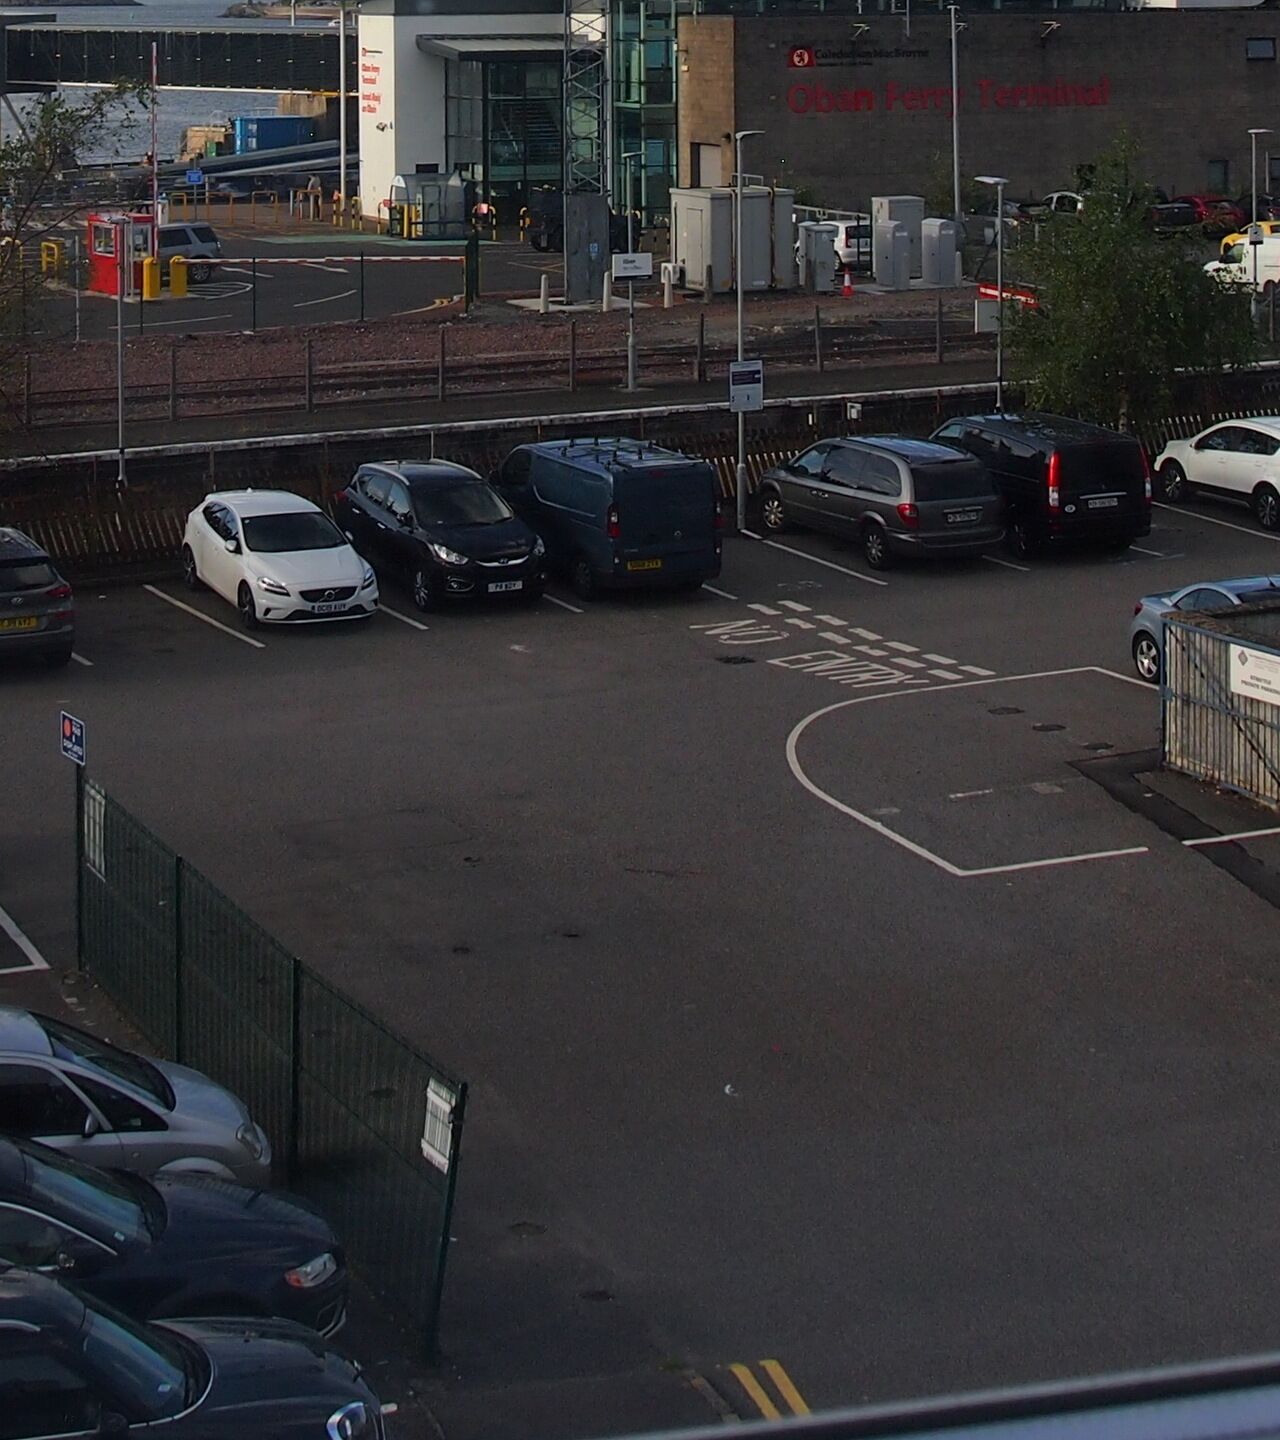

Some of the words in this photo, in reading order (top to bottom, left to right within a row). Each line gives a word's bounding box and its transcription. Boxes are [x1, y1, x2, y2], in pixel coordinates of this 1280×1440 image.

[787, 81, 875, 113] Oban
[884, 79, 965, 118] Ferry
[976, 75, 1111, 111] Terminal
[688, 619, 791, 644] NO
[765, 650, 930, 688] ENTRY
